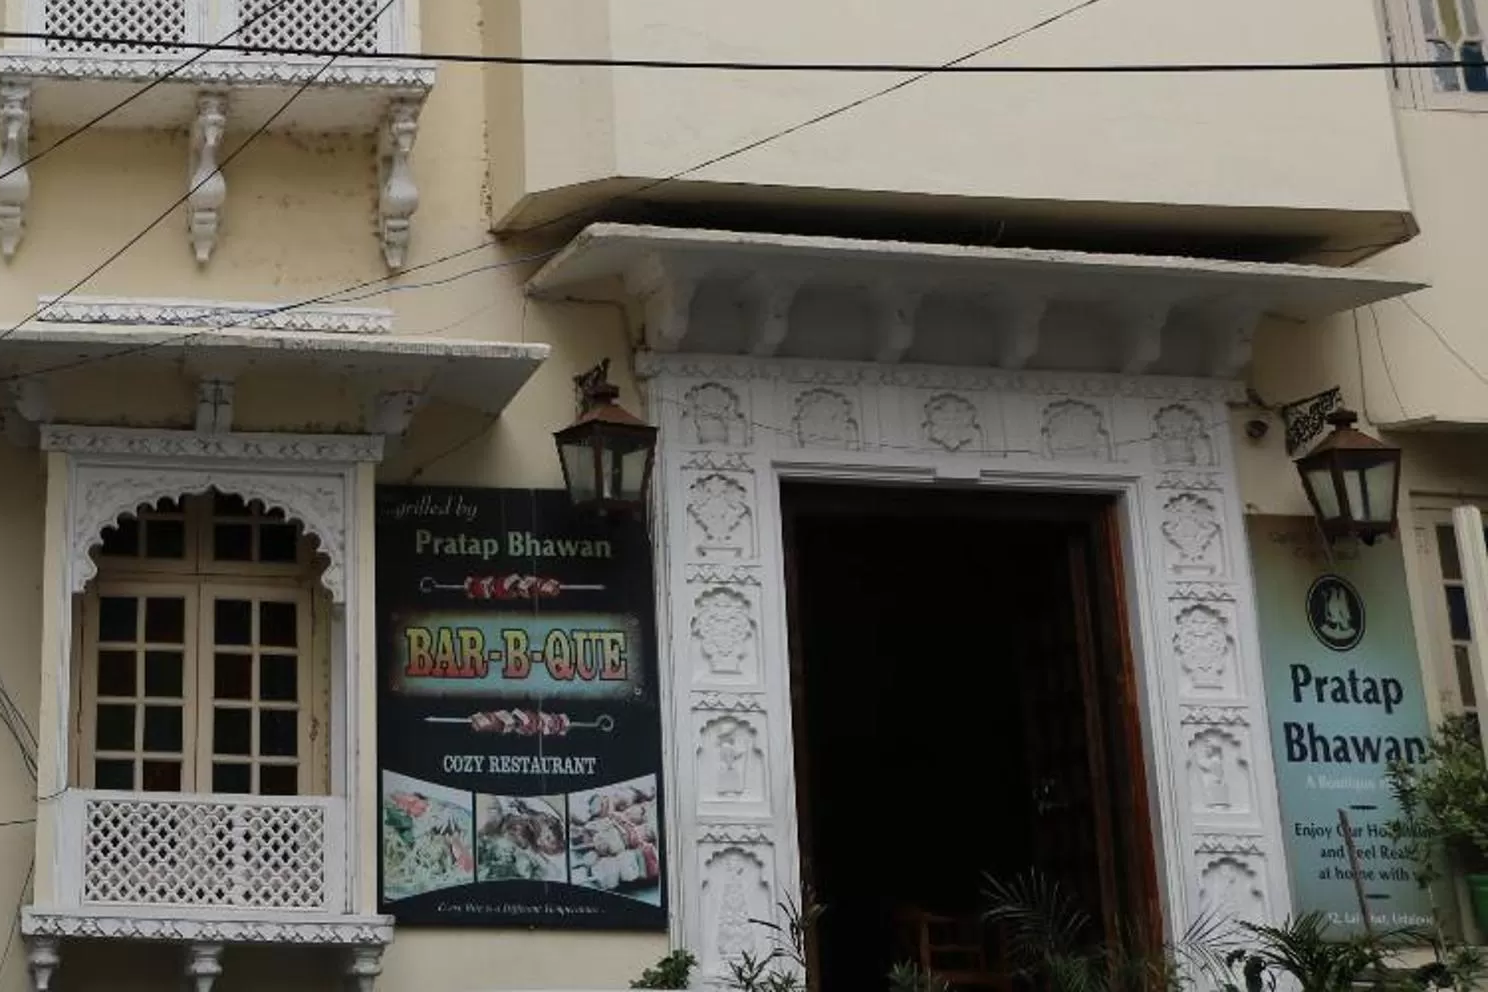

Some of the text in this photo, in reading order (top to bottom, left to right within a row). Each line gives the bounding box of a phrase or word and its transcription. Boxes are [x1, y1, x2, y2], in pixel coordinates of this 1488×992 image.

[455, 494, 479, 523] by
[415, 528, 613, 561] Pratap Bhawan
[405, 625, 629, 682] BAR-B-QUE
[1289, 663, 1405, 715] Pratap
[1283, 721, 1427, 765] Bhawan
[443, 755, 597, 776] COZY RESTAURANT
[1295, 822, 1333, 839] Enjoy
[1320, 846, 1345, 860] and
[1349, 845, 1376, 861] eel
[1319, 869, 1331, 881] at
[1379, 866, 1410, 882] with
